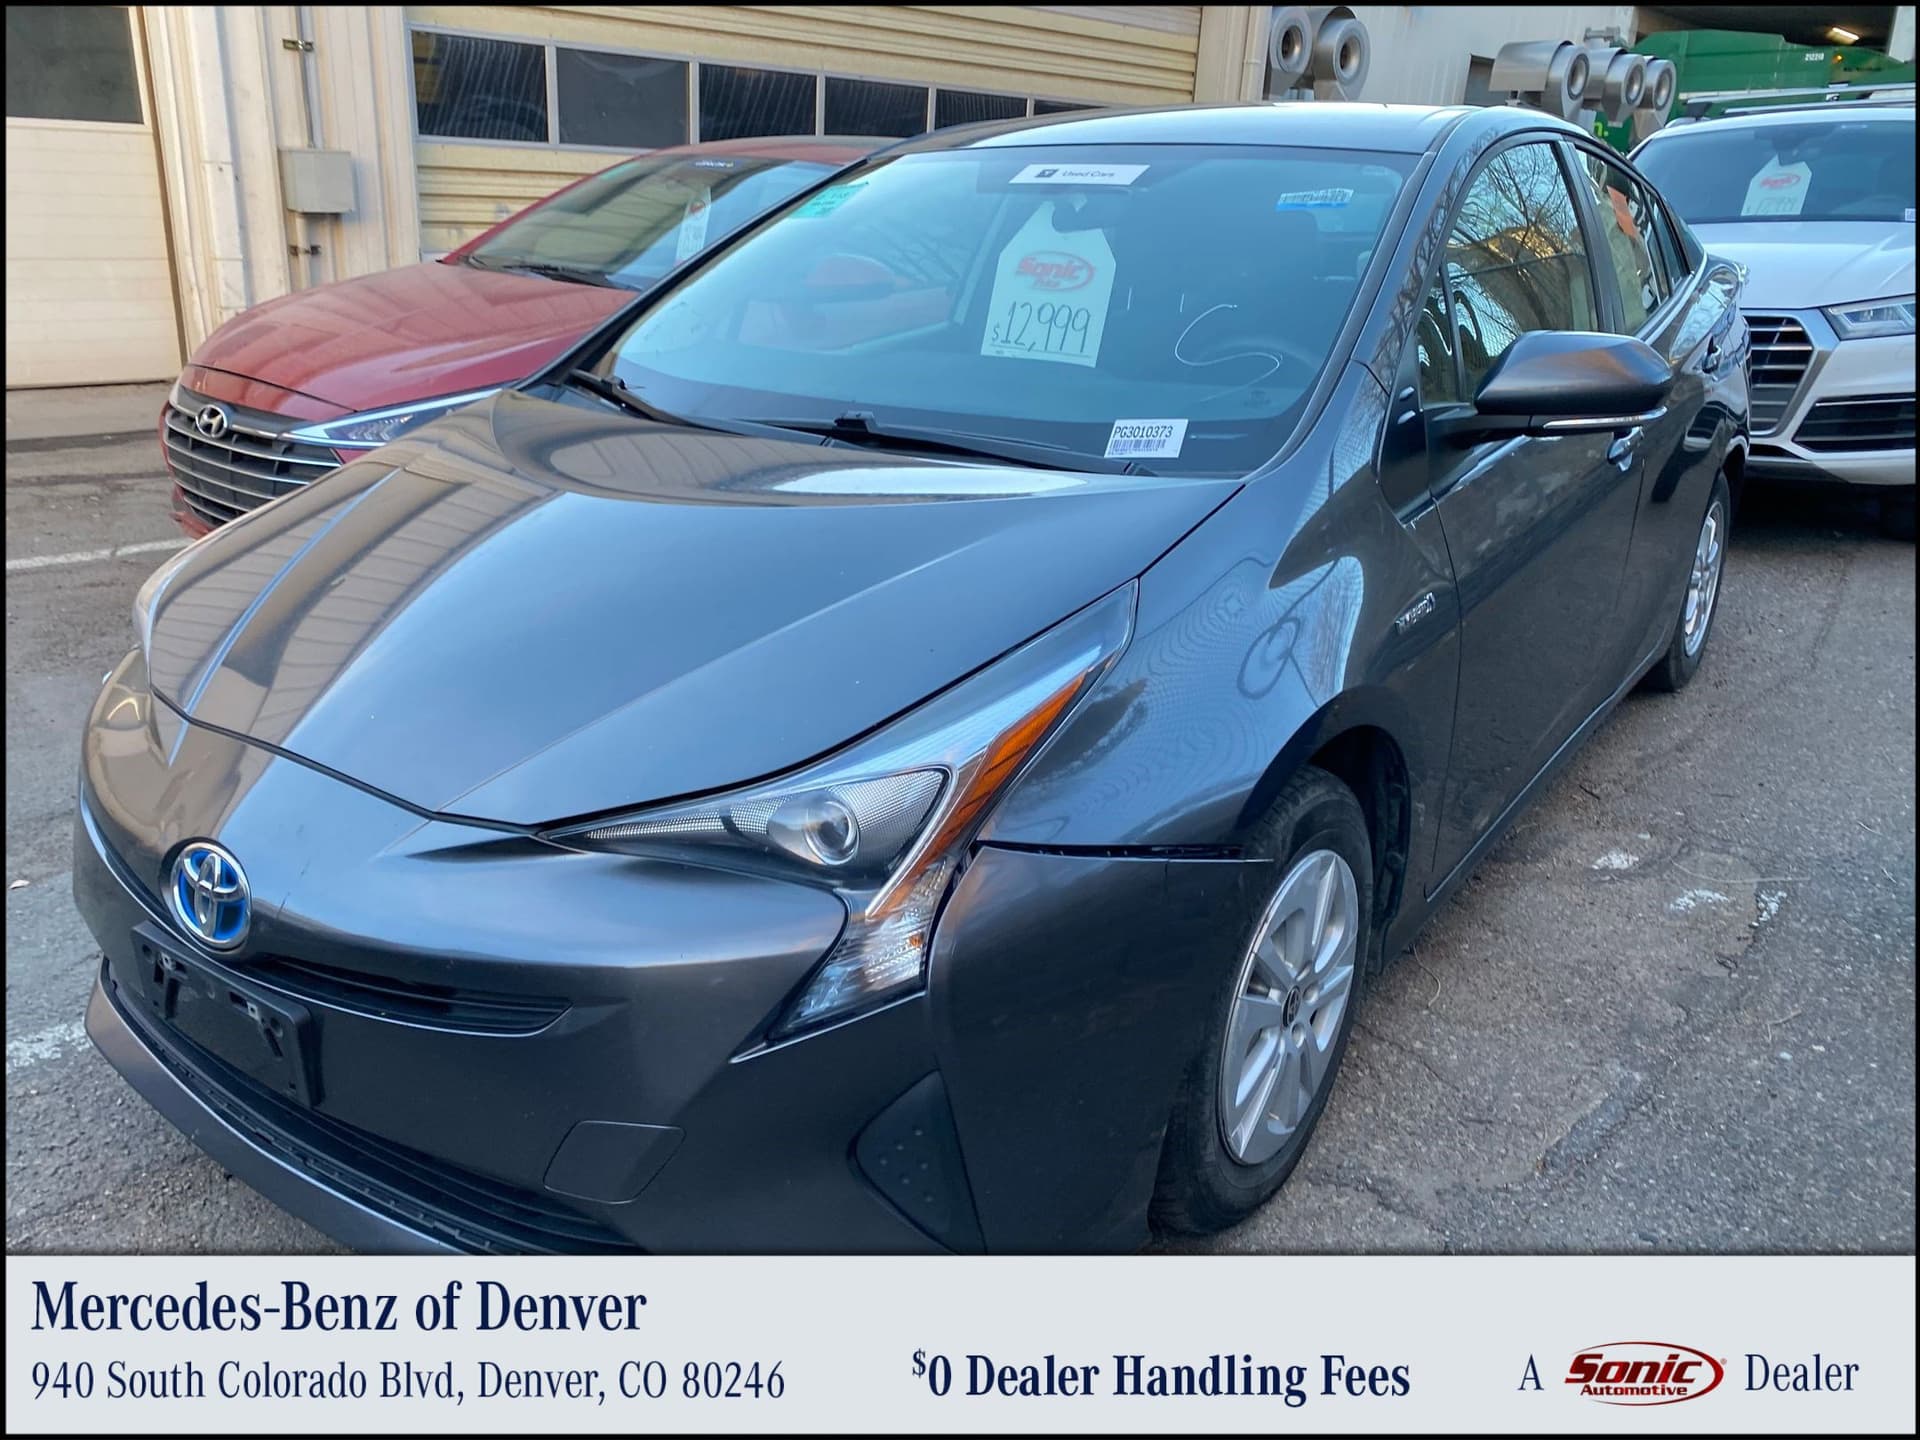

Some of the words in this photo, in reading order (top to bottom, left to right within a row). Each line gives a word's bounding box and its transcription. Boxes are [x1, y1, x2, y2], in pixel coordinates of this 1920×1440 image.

[1015, 256, 1084, 279] Sonic
[991, 300, 1092, 353] $12,999
[1112, 425, 1174, 438] PG3010373
